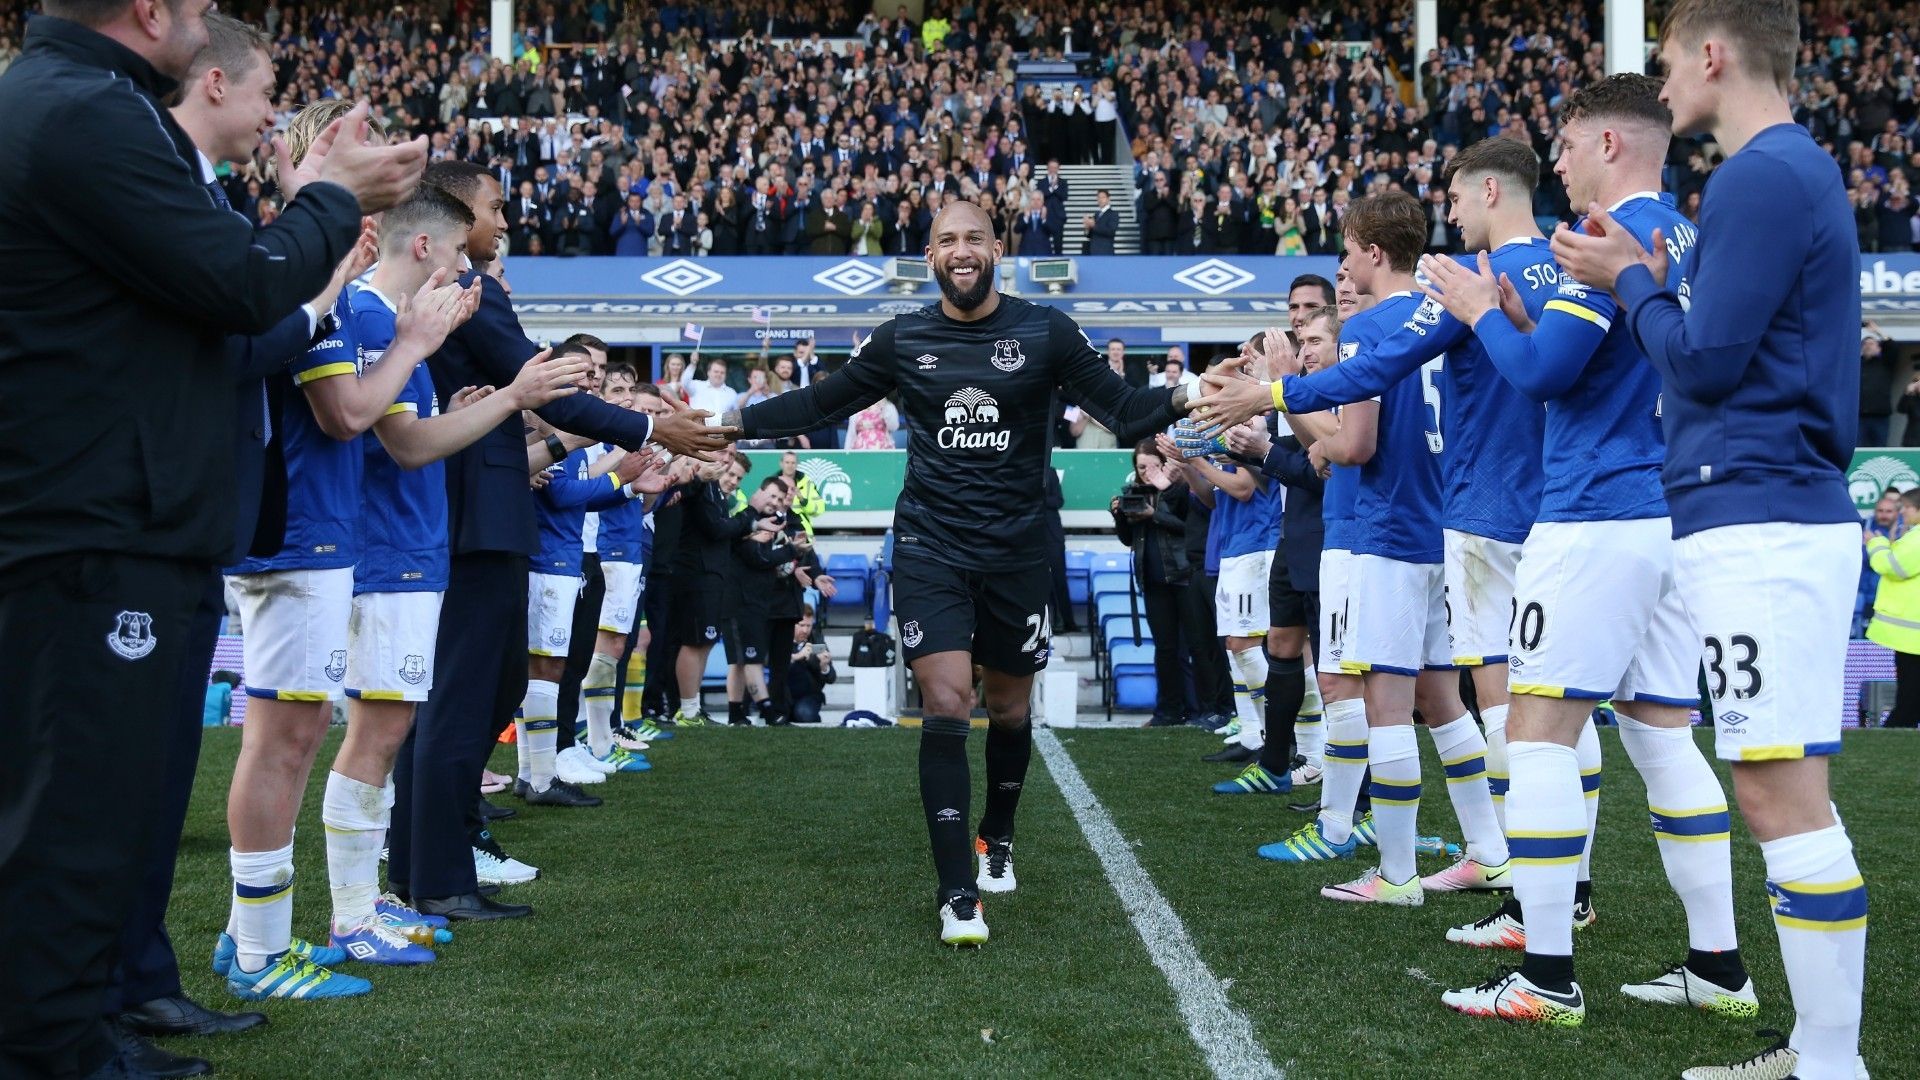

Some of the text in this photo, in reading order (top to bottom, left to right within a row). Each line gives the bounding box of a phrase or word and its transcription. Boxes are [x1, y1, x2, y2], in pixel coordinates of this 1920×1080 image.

[1523, 263, 1557, 290] STO
[1073, 301, 1234, 312] SATIS
[755, 330, 815, 339] CHANG BEER
[938, 427, 1010, 451] Chang
[1239, 593, 1252, 615] 11
[1021, 602, 1049, 653] 24
[121, 636, 146, 645] Everton
[1703, 633, 1764, 700] 33
[1723, 726, 1747, 735] umbro
